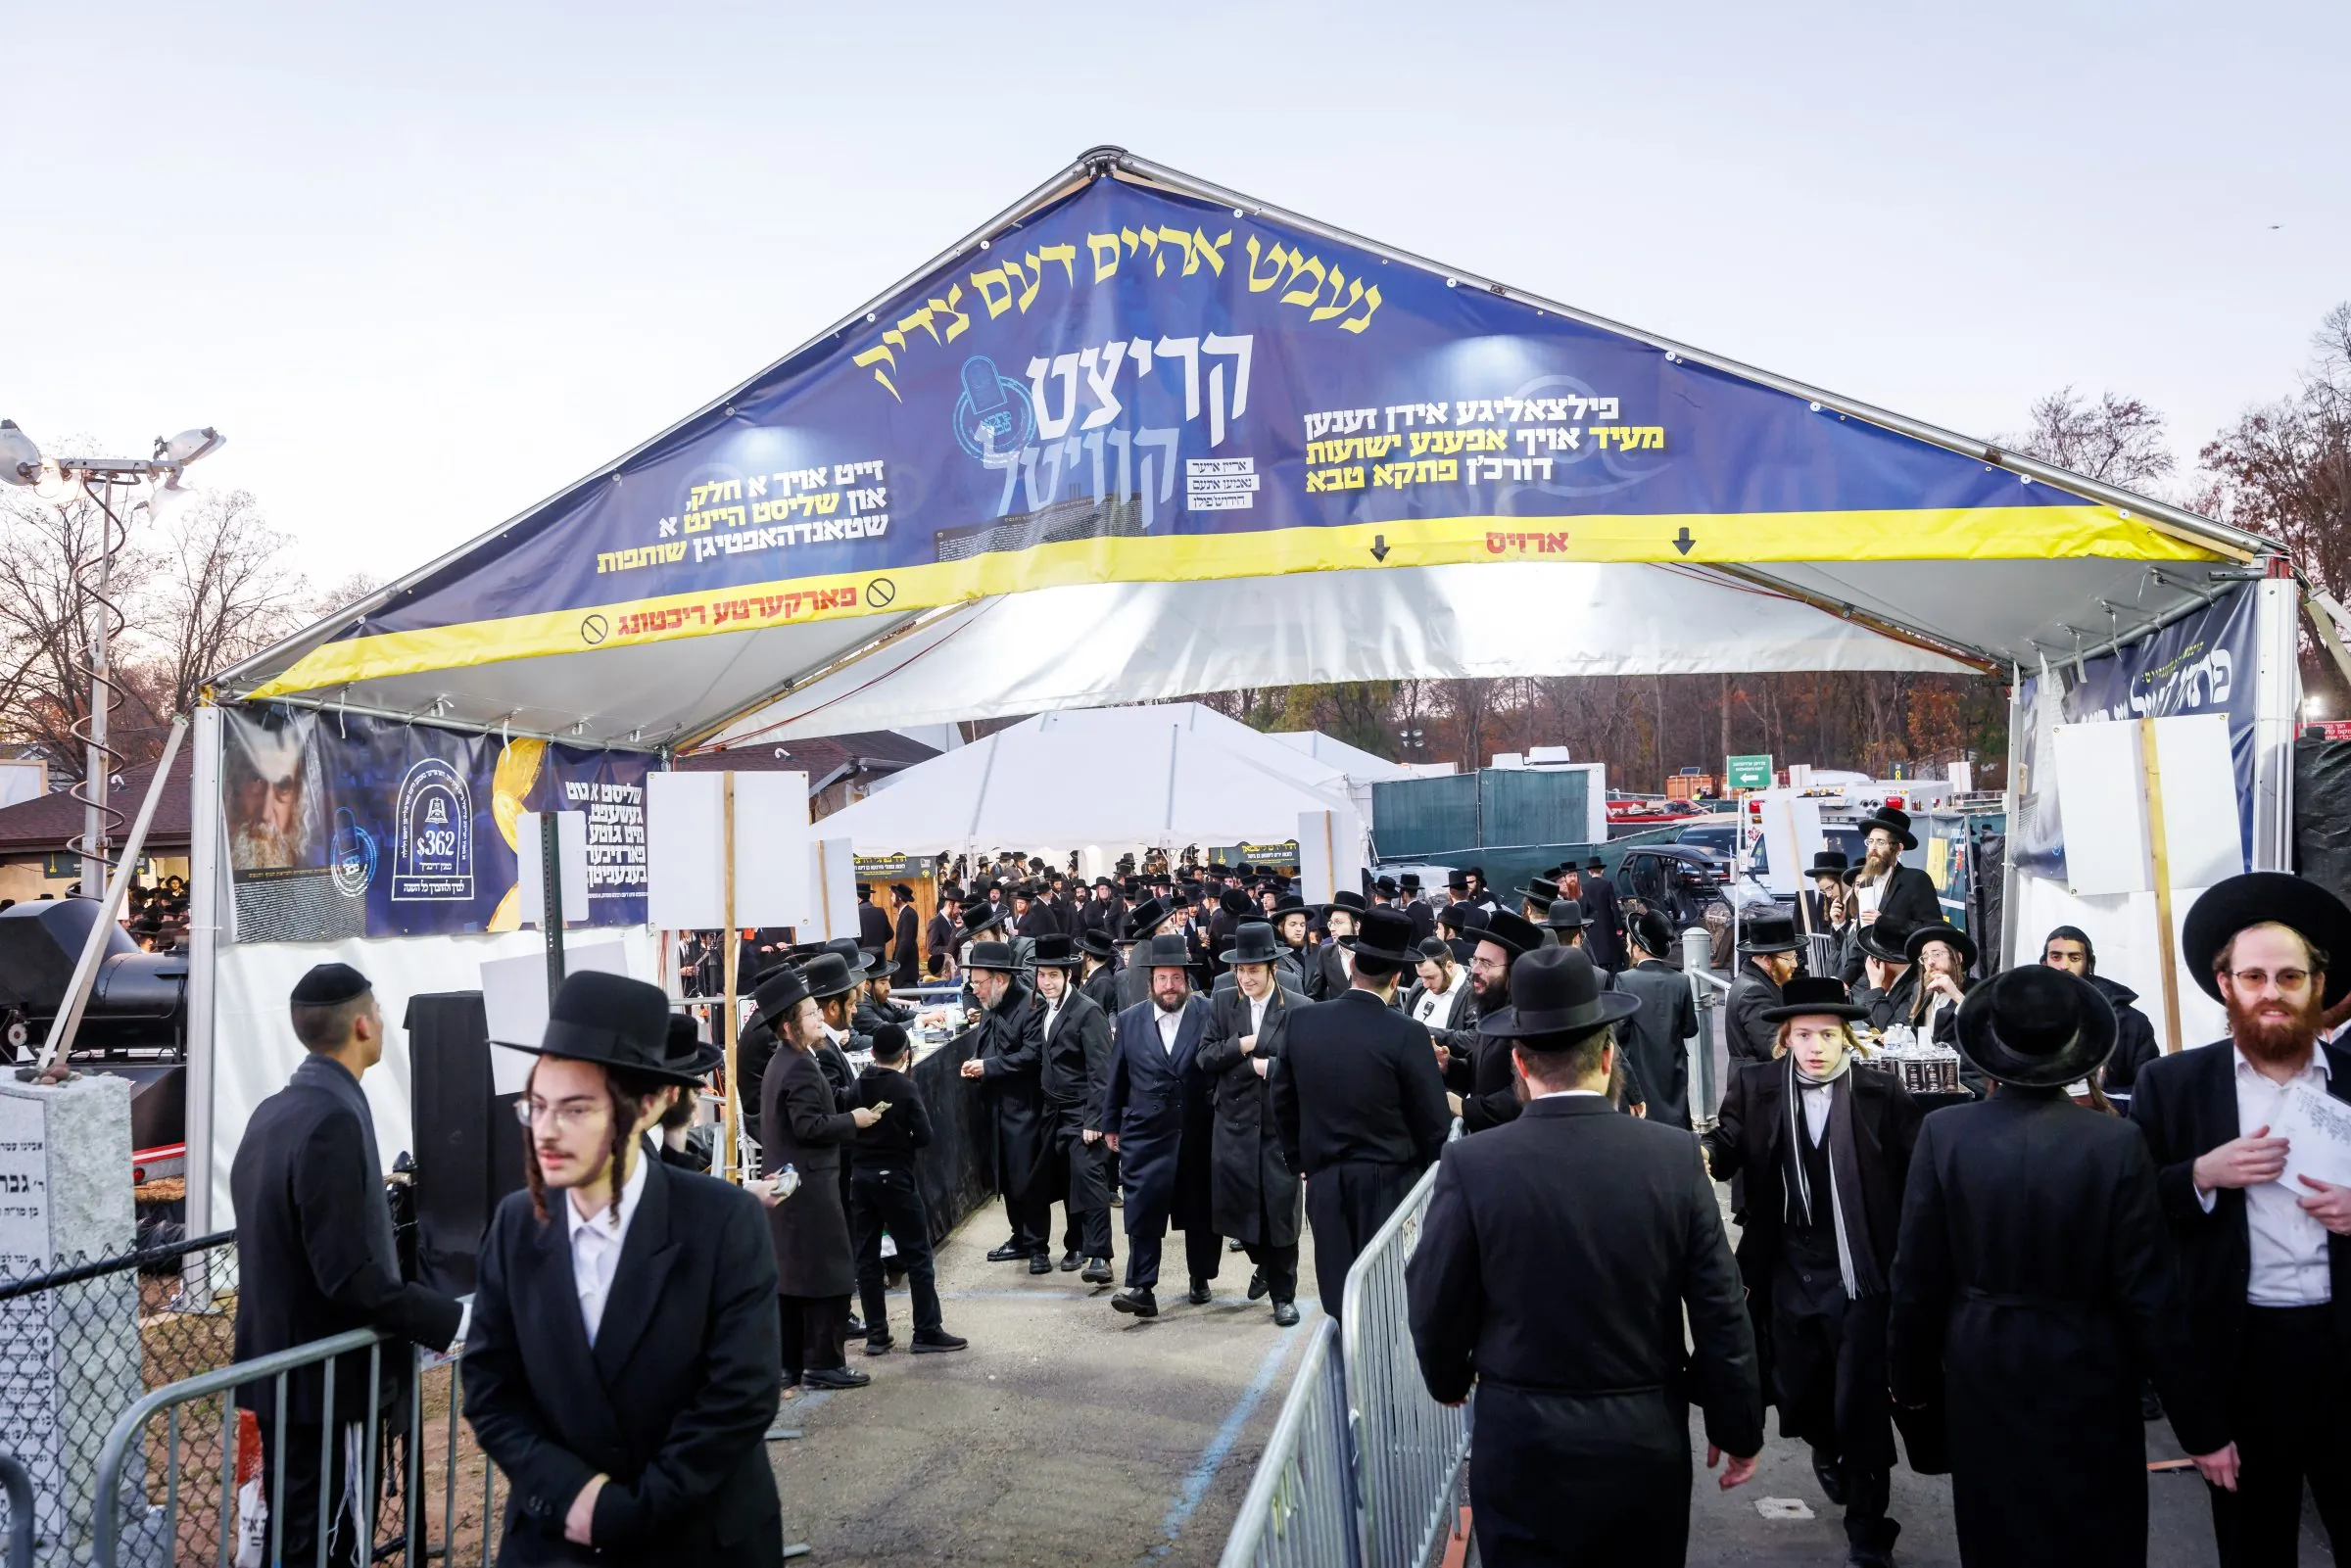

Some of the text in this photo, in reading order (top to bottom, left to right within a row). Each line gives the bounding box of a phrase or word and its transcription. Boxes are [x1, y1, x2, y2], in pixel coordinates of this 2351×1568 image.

[852, 223, 1382, 404] נעמט אהיים דעם צדיק
[1026, 332, 1253, 448] קריצט
[1304, 395, 1619, 441] פילצאליגע אידן זענען
[1306, 426, 1664, 465] מעיד אויף אפענע ישועות
[747, 475, 768, 498] א
[773, 466, 828, 498] אויך
[834, 459, 884, 486] זייט
[974, 418, 1179, 529] קוויטל
[1306, 464, 1366, 493] טבא
[1372, 458, 1458, 490] פתקא
[658, 488, 888, 539] און שליסט היינט א
[597, 514, 889, 574] שטאנדהאפטיגן שותפות
[1486, 532, 1568, 554] ארויס
[617, 587, 858, 636] פארקערטע ריכטונג
[565, 782, 643, 804] שליסט א גוט
[416, 830, 455, 857] $362
[590, 824, 645, 845] מיט גוטע
[0, 1174, 30, 1193] גבר
